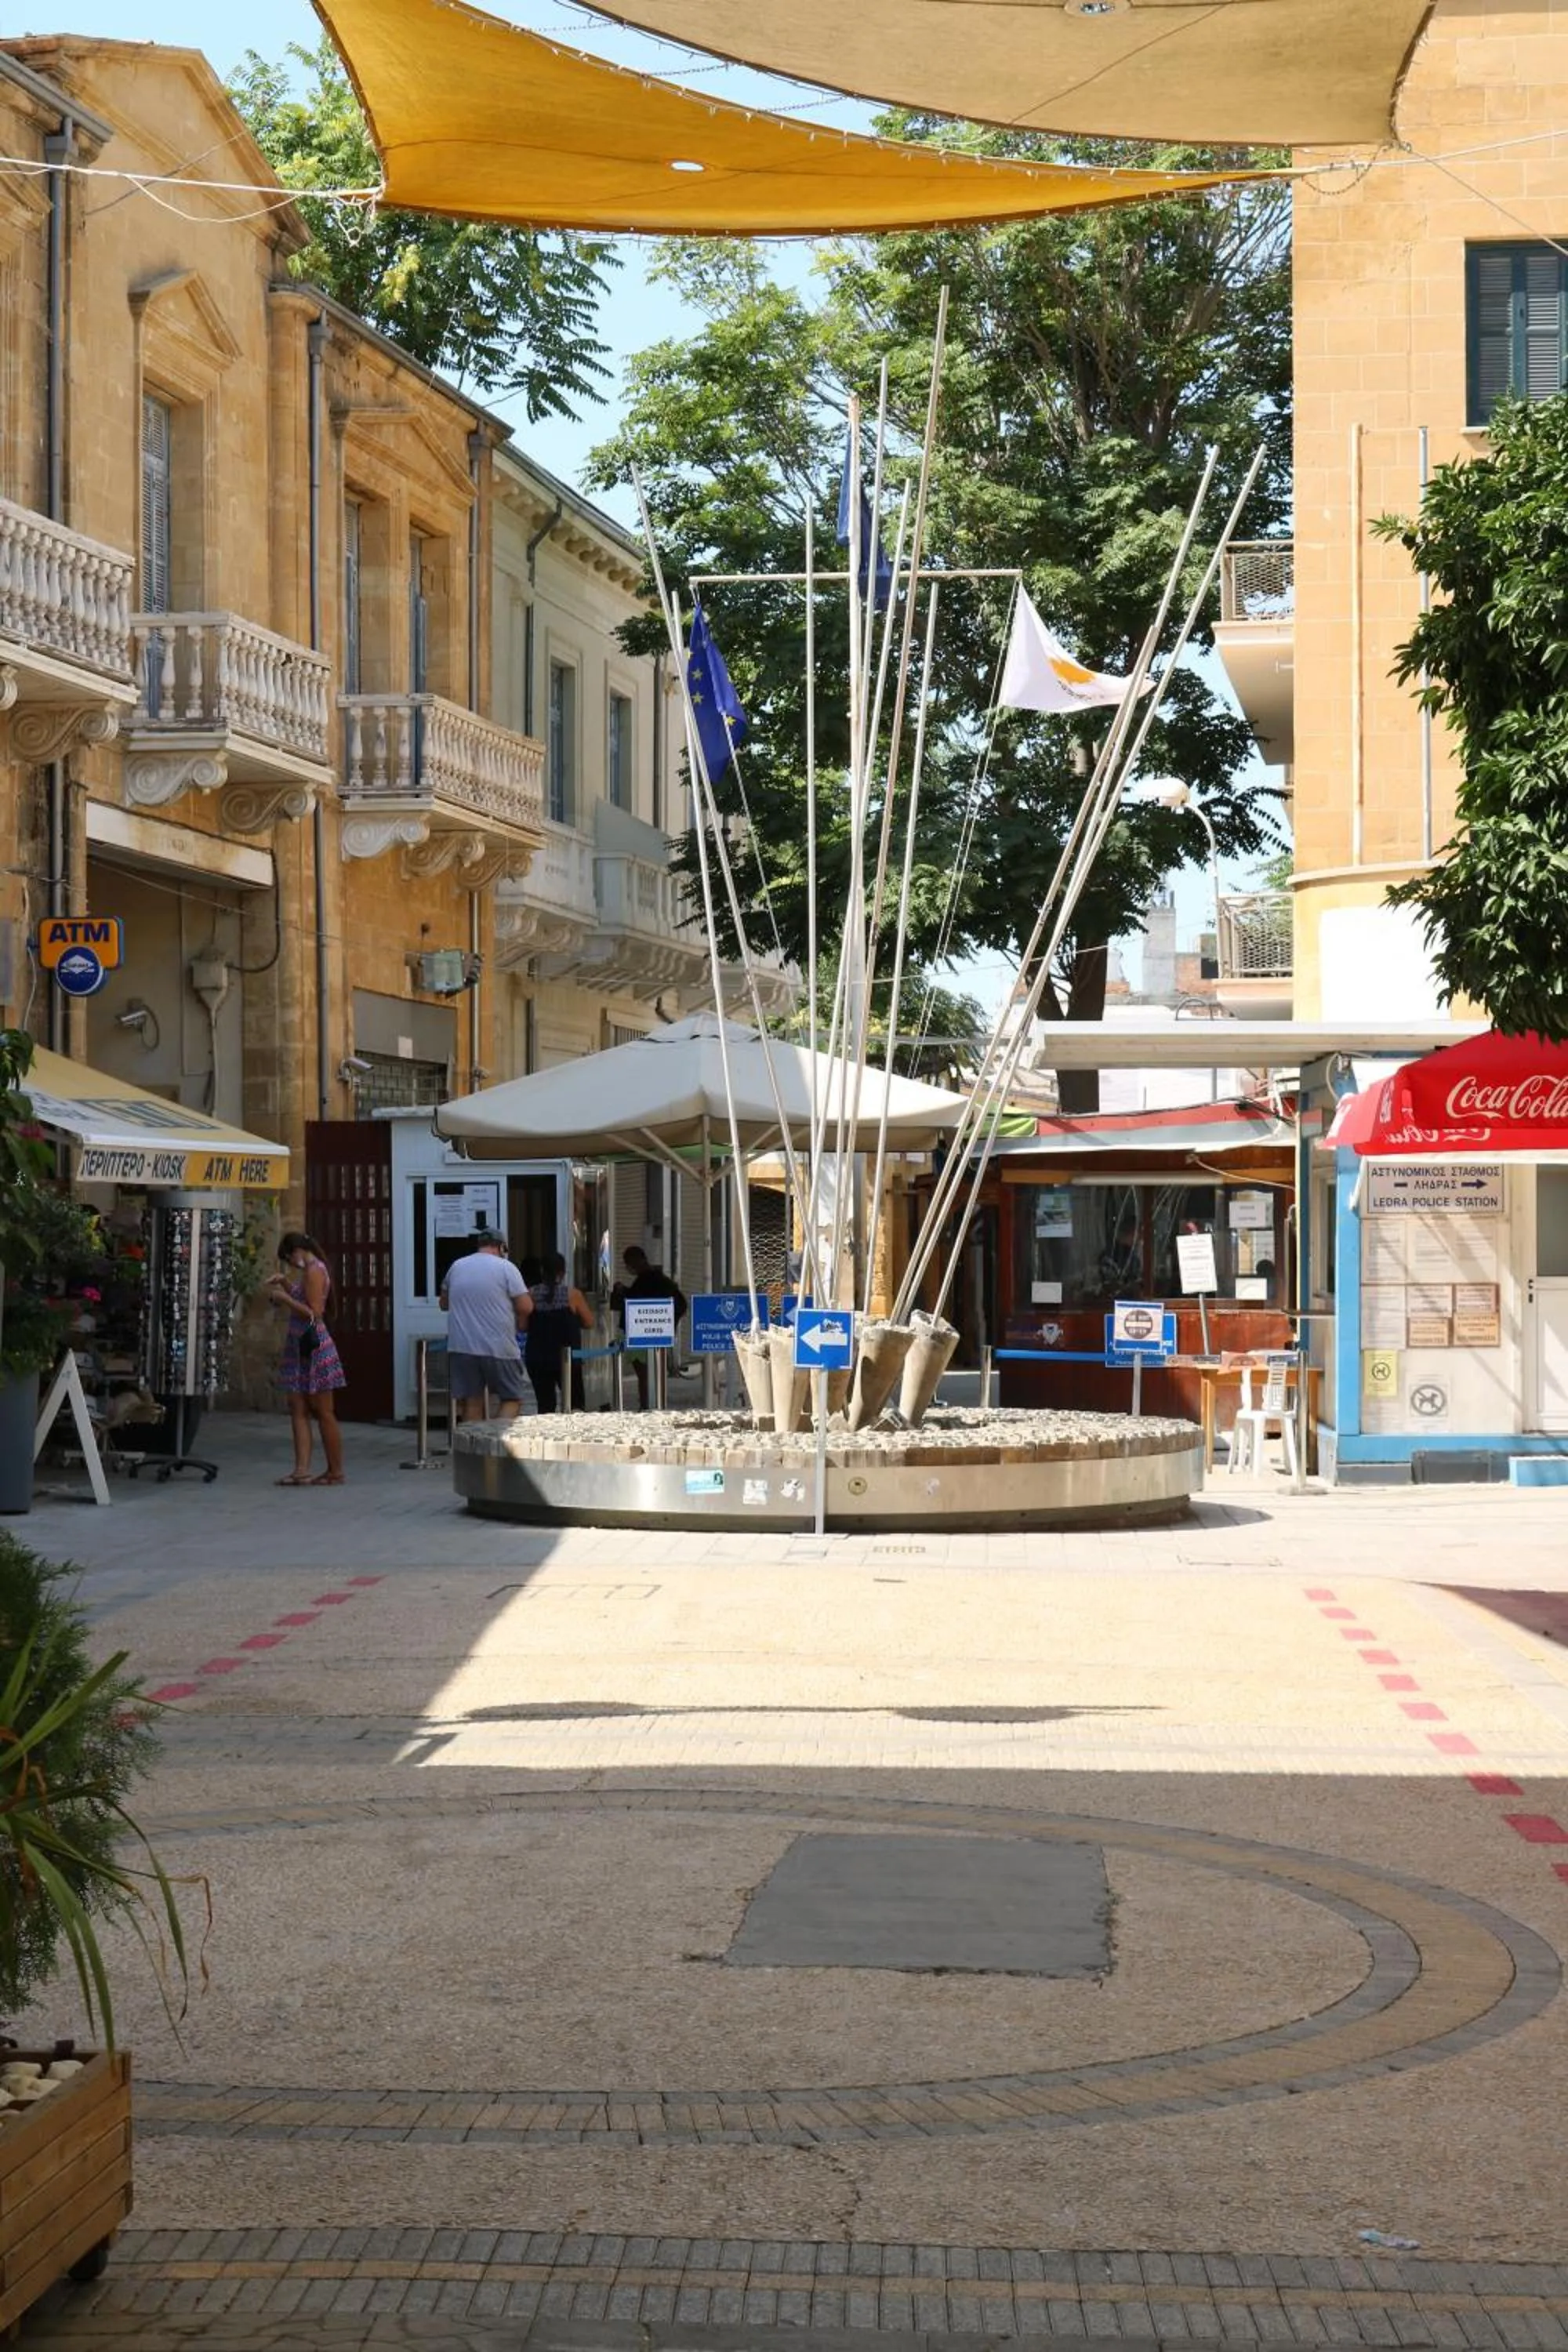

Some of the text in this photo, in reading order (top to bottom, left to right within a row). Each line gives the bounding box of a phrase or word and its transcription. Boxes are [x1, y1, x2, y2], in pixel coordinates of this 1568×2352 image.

[49, 923, 110, 942] ATM
[1446, 1075, 1568, 1120] Coca-Cola
[151, 1153, 186, 1180] KIOSK
[203, 1156, 270, 1183] ATM HERE
[1371, 1167, 1500, 1177] ΑΣΤΥΝΟΜΙΚΟΣ ΣΤΑΘΜΟΣ
[1414, 1180, 1457, 1189] ΛΗΔΡΑΣ
[1373, 1197, 1498, 1207] LEDRA POLICE STATION
